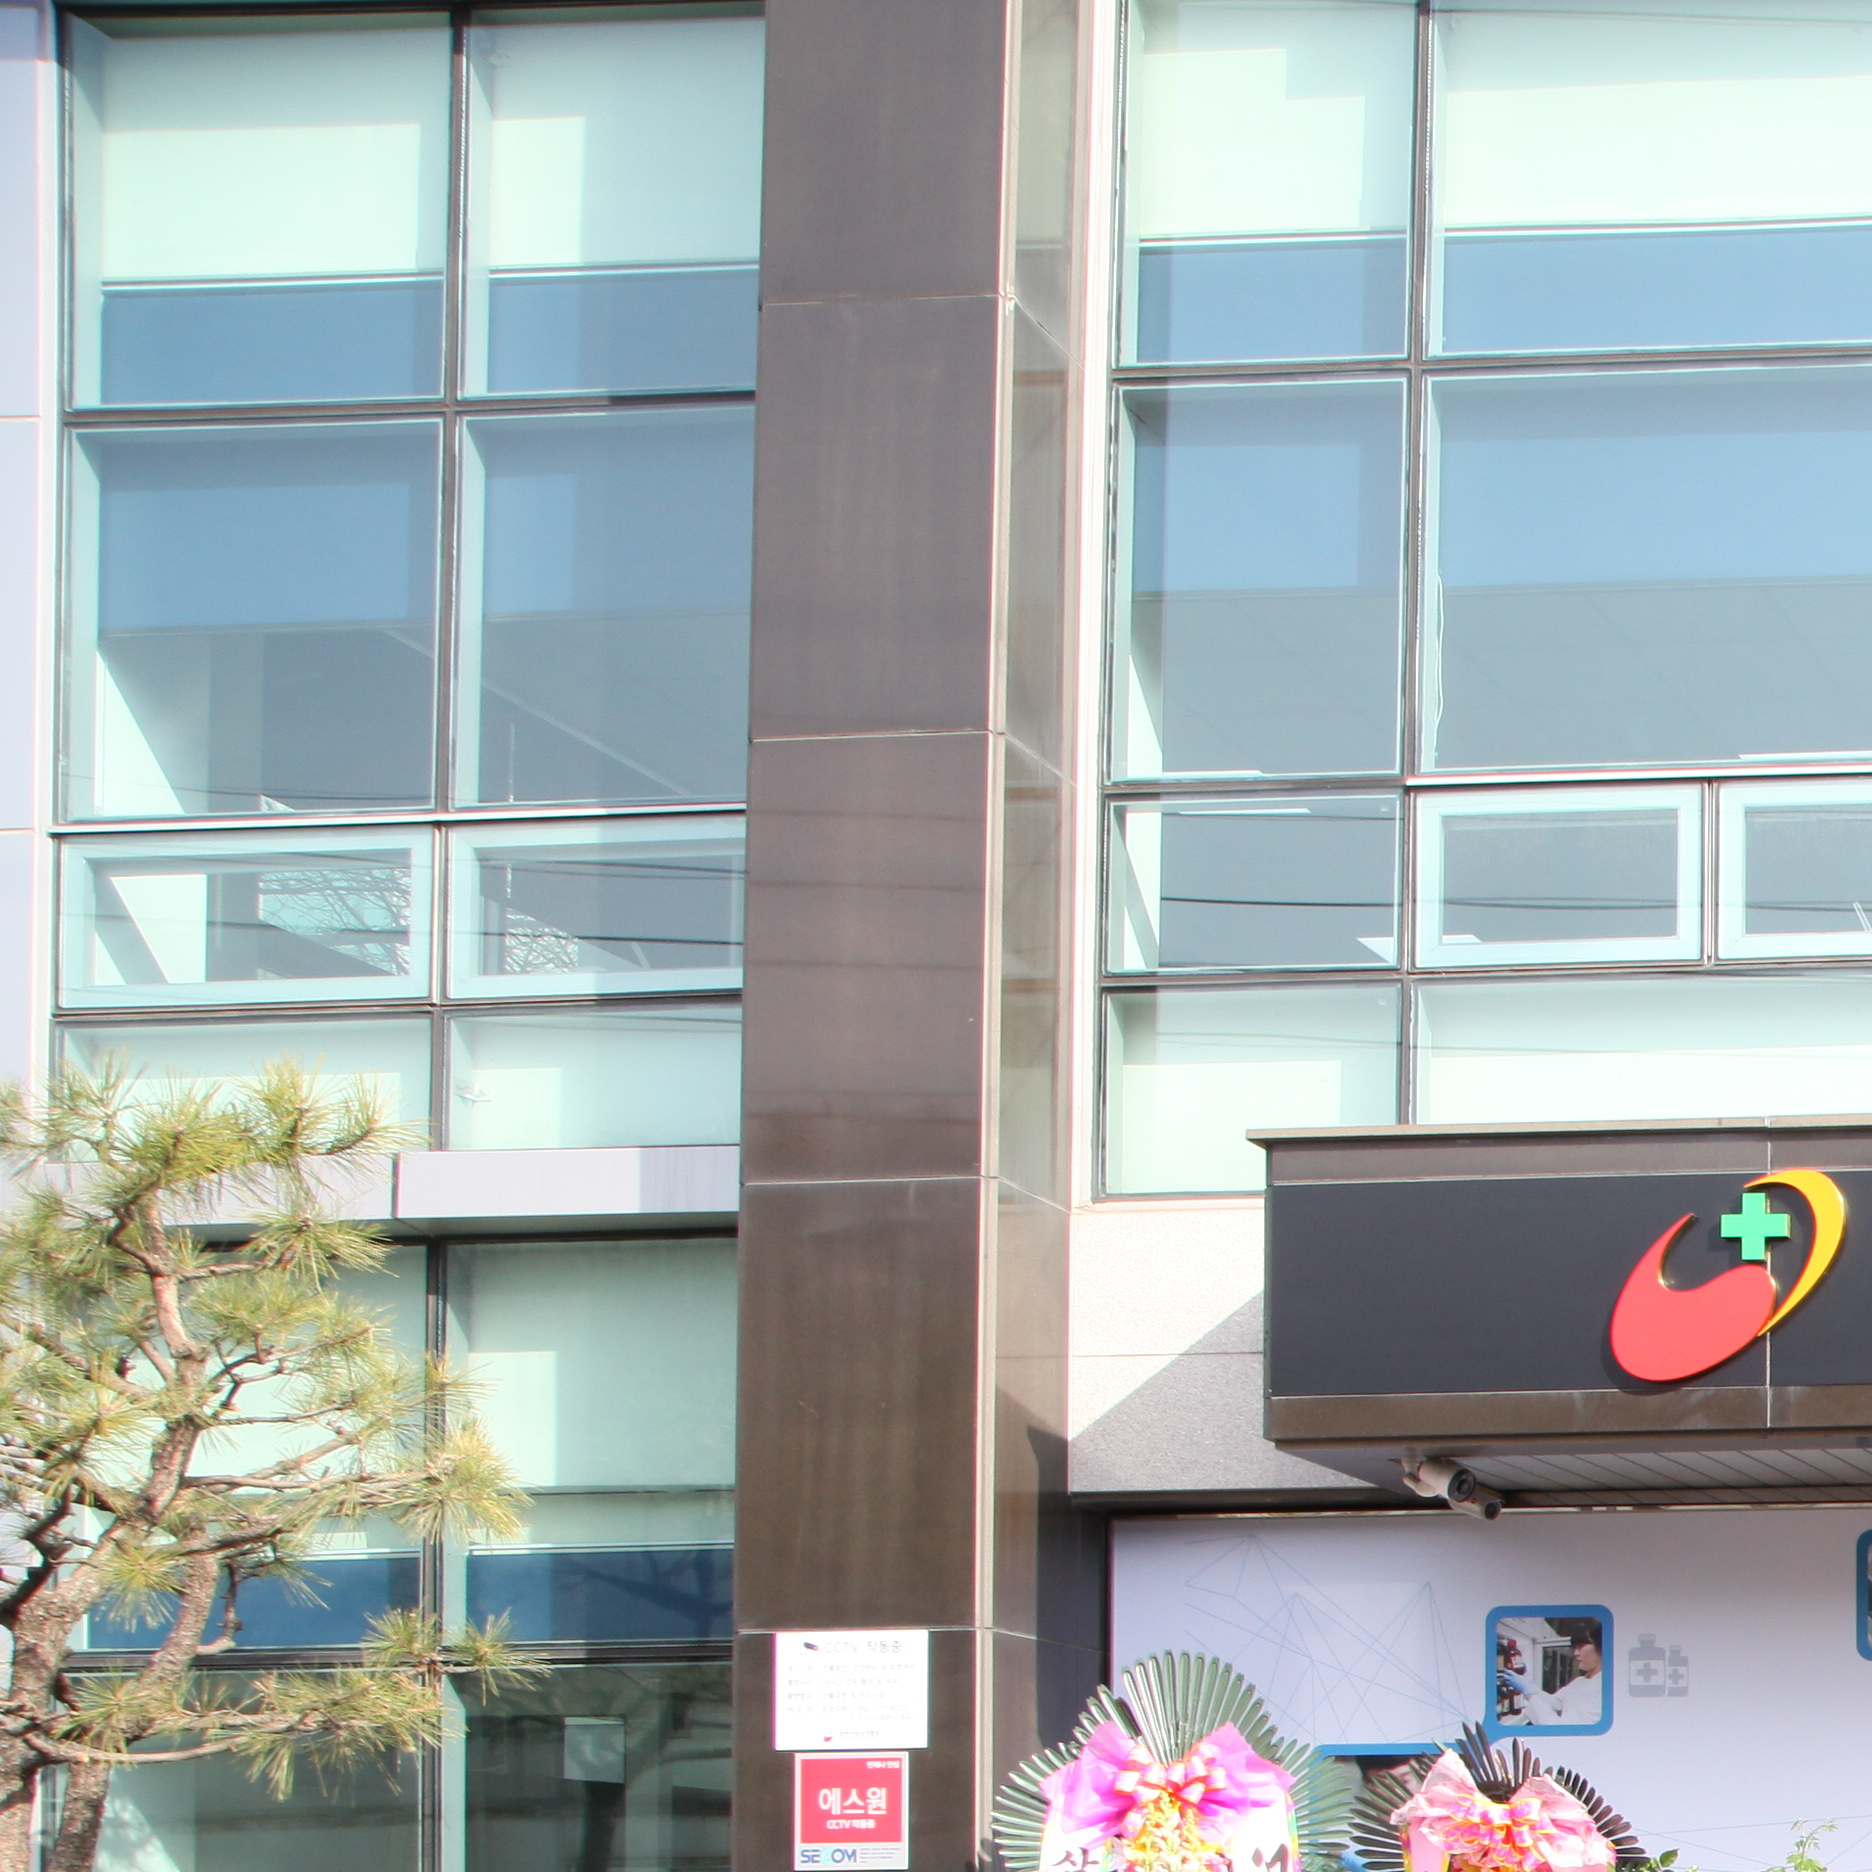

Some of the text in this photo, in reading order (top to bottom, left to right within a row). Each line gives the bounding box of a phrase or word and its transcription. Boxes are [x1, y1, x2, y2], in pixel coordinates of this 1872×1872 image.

[824, 1640, 902, 1654] CCTV 작동중
[818, 1786, 887, 1816] 에스원
[826, 1818, 851, 1830] CCTV
[800, 1847, 858, 1865] SECOM
